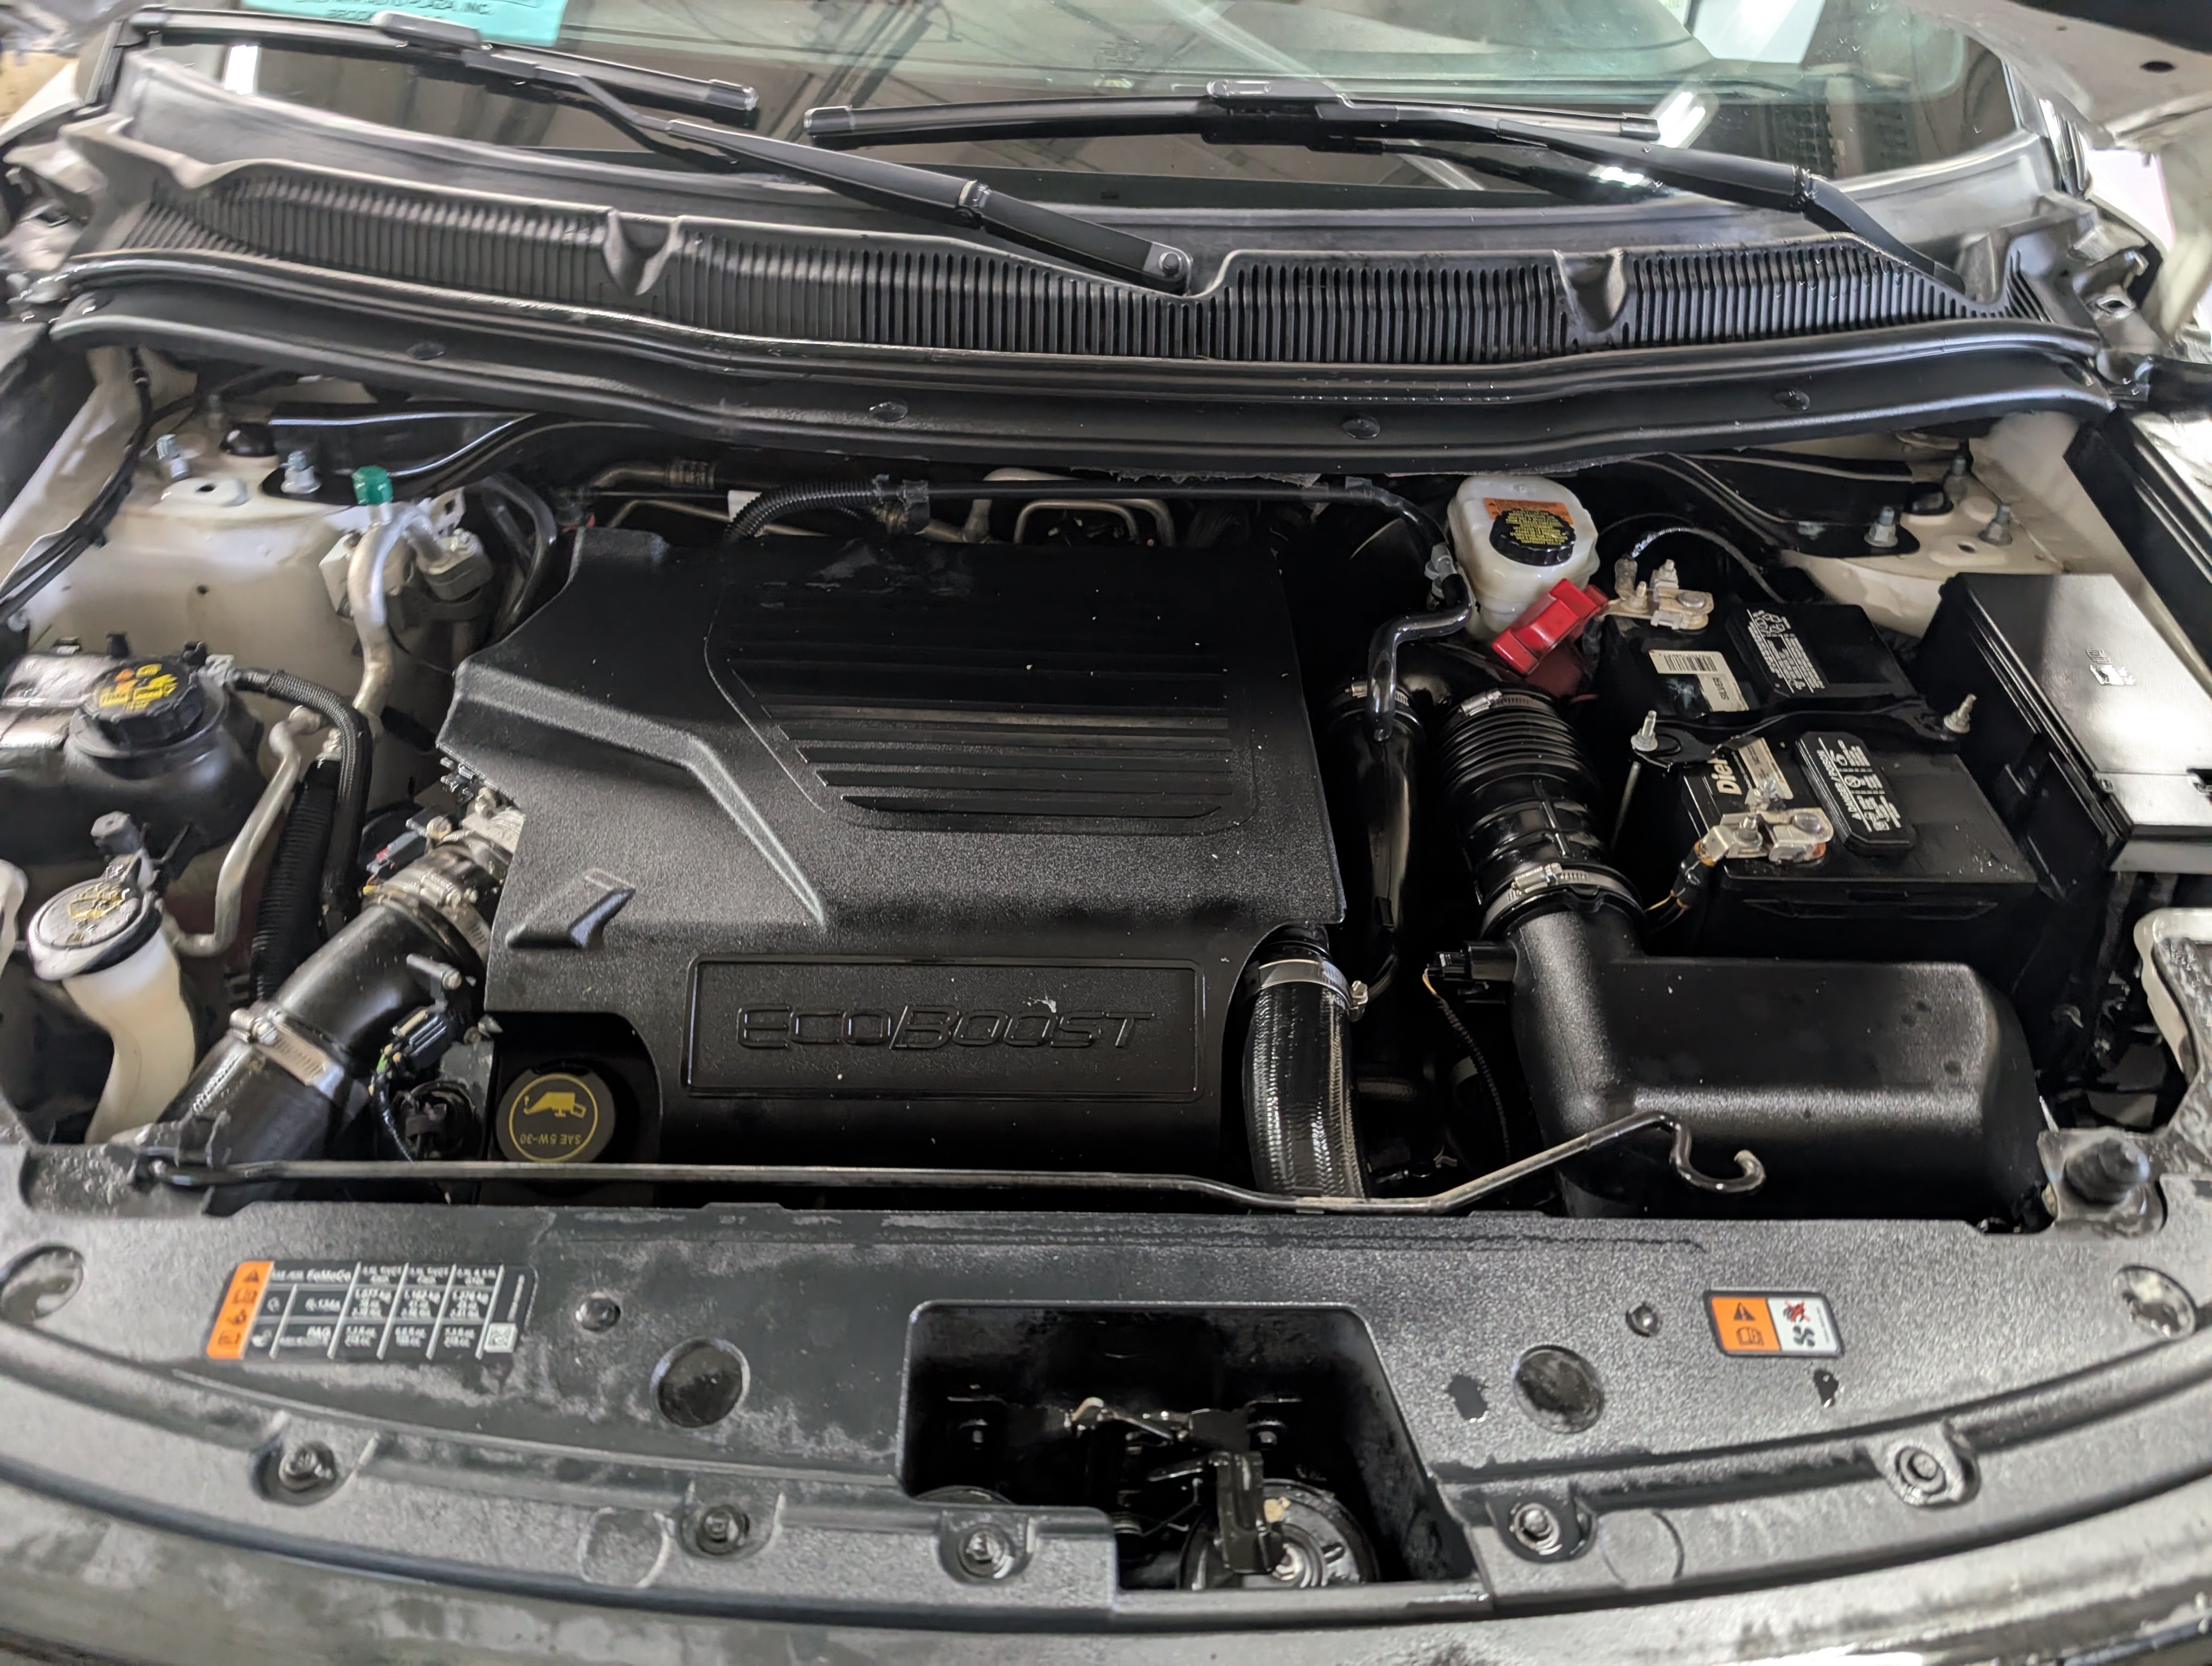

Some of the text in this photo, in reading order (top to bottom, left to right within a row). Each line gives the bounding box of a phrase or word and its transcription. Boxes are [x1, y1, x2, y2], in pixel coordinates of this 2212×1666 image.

[1816, 749, 1838, 777] POISON
[1835, 781, 1857, 812] DANGER
[519, 1133, 582, 1145] SAE 5W-30
